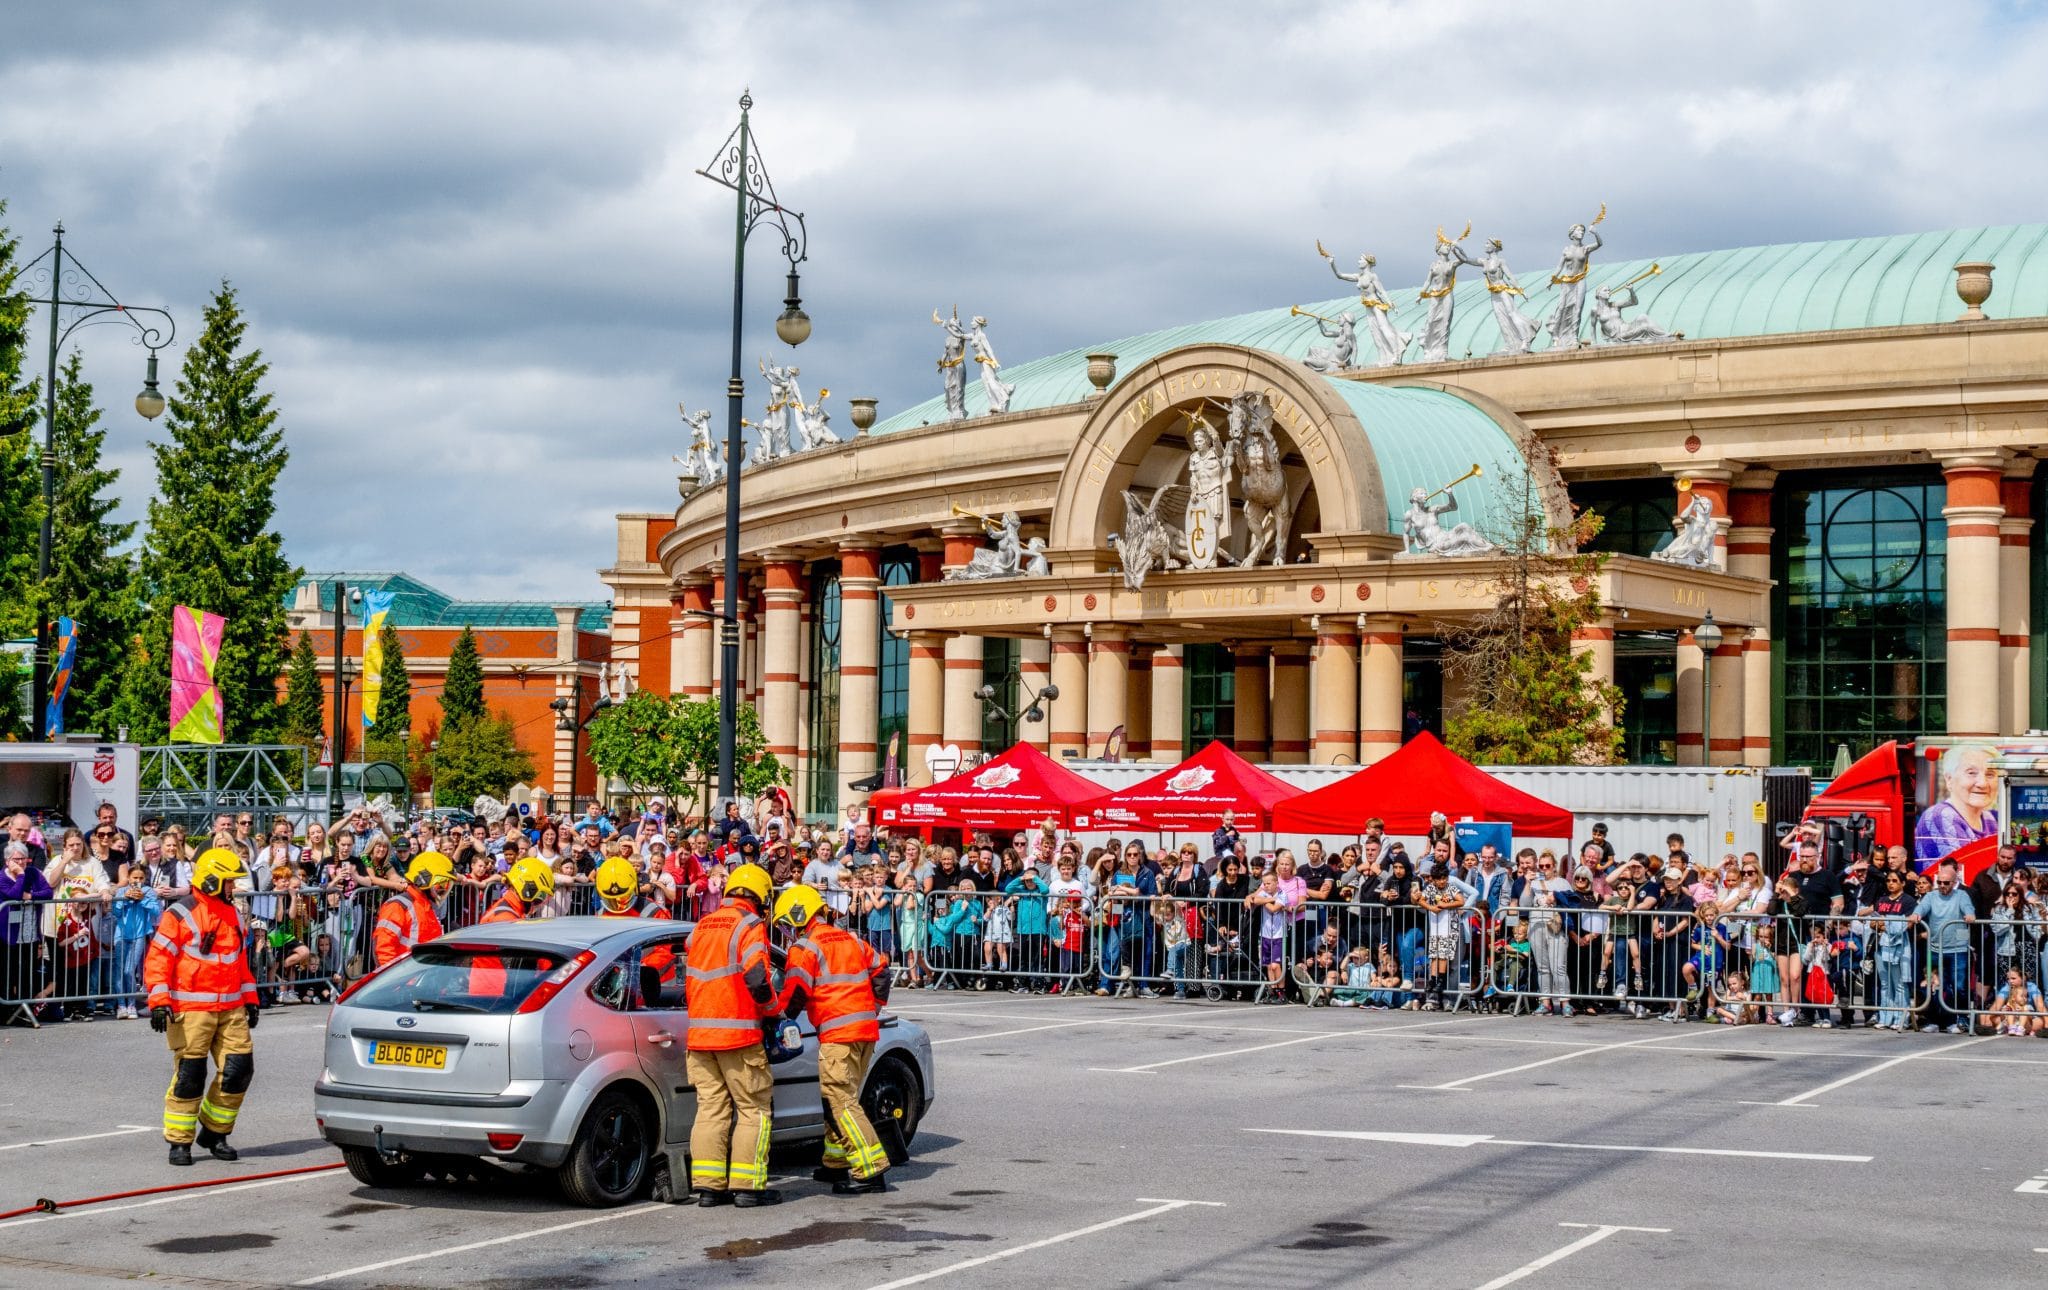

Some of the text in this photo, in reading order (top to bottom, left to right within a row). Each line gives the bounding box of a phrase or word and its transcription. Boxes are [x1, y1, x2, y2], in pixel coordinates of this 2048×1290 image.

[1086, 371, 1331, 486] THE TRAFFORD CENTRE
[1818, 420, 2048, 446] THE TRA
[1200, 585, 1276, 608] WHICH
[1417, 579, 1439, 600] IS
[377, 1044, 444, 1066] BL06 OPC
